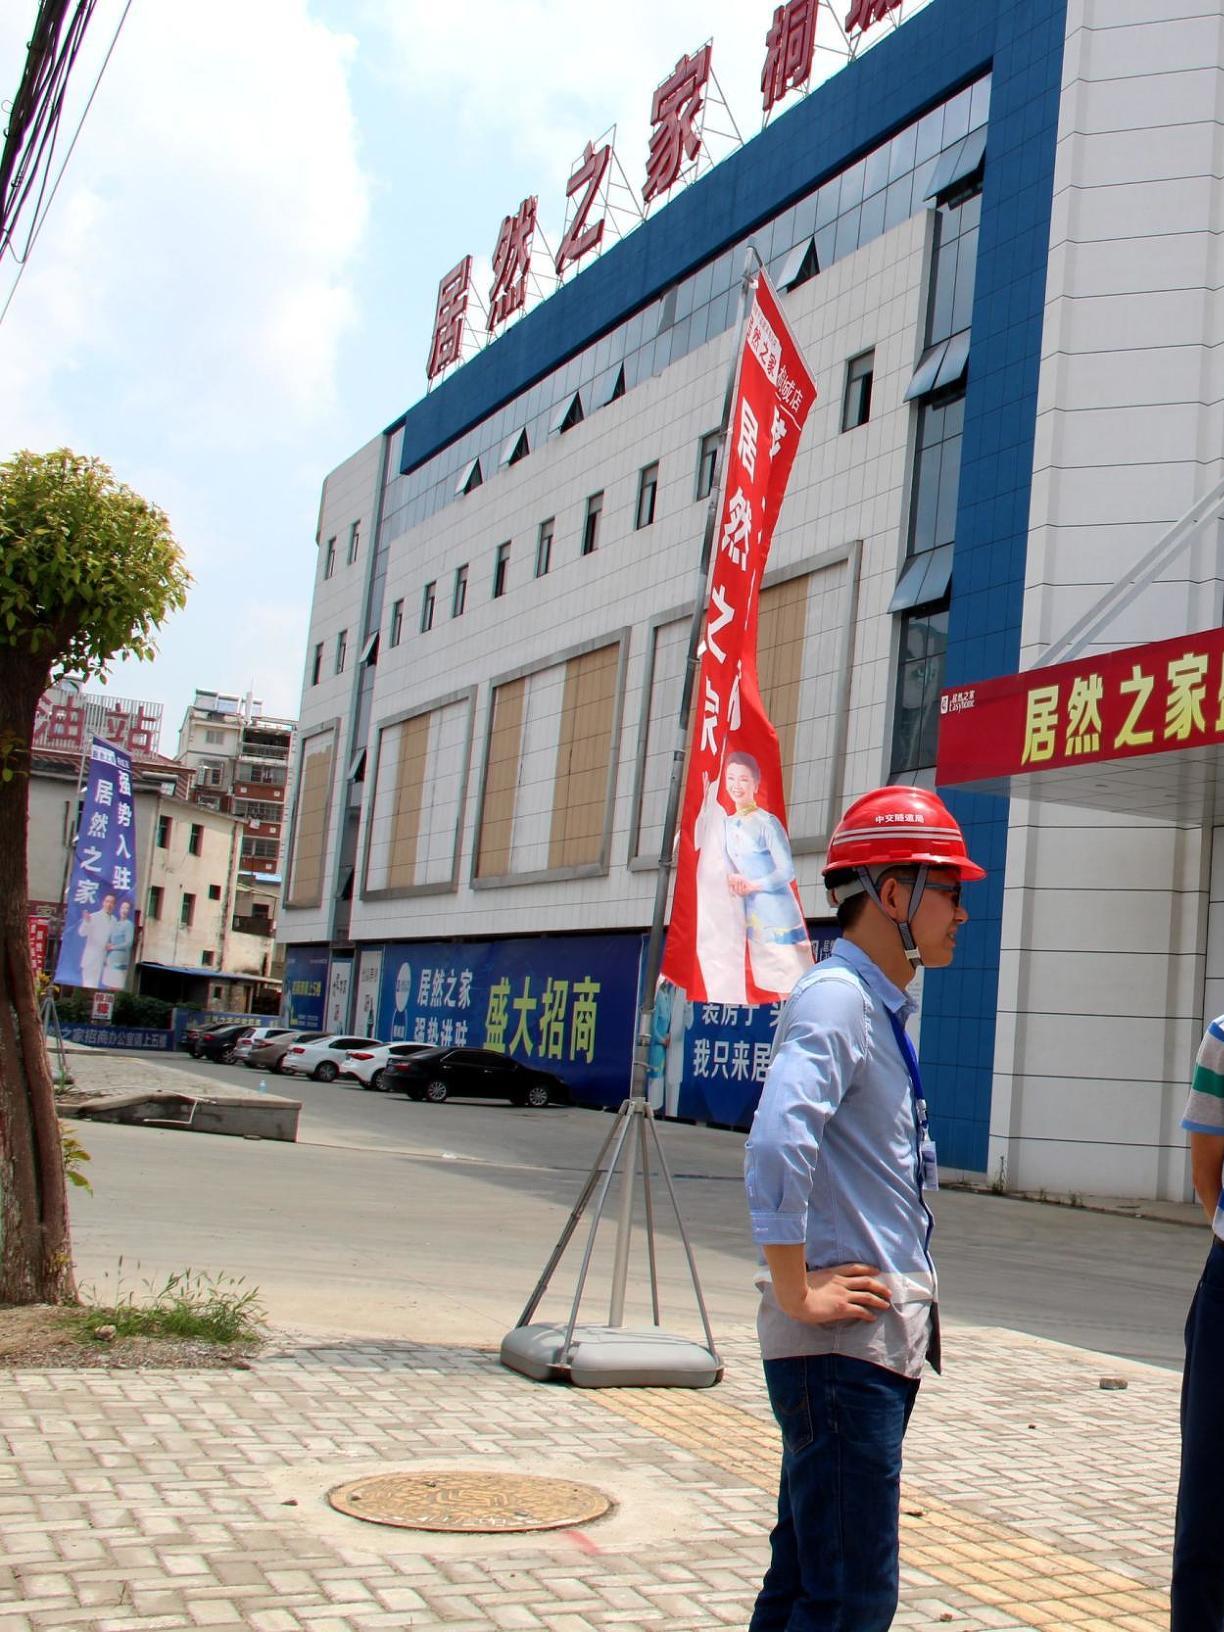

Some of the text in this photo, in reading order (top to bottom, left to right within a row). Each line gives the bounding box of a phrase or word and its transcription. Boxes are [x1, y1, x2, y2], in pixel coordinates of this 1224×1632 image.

[74, 779, 113, 905] 居然之家
[112, 769, 133, 891] 强势入驻
[417, 968, 473, 1010] 居然之家
[484, 975, 601, 1064] 盛大招商
